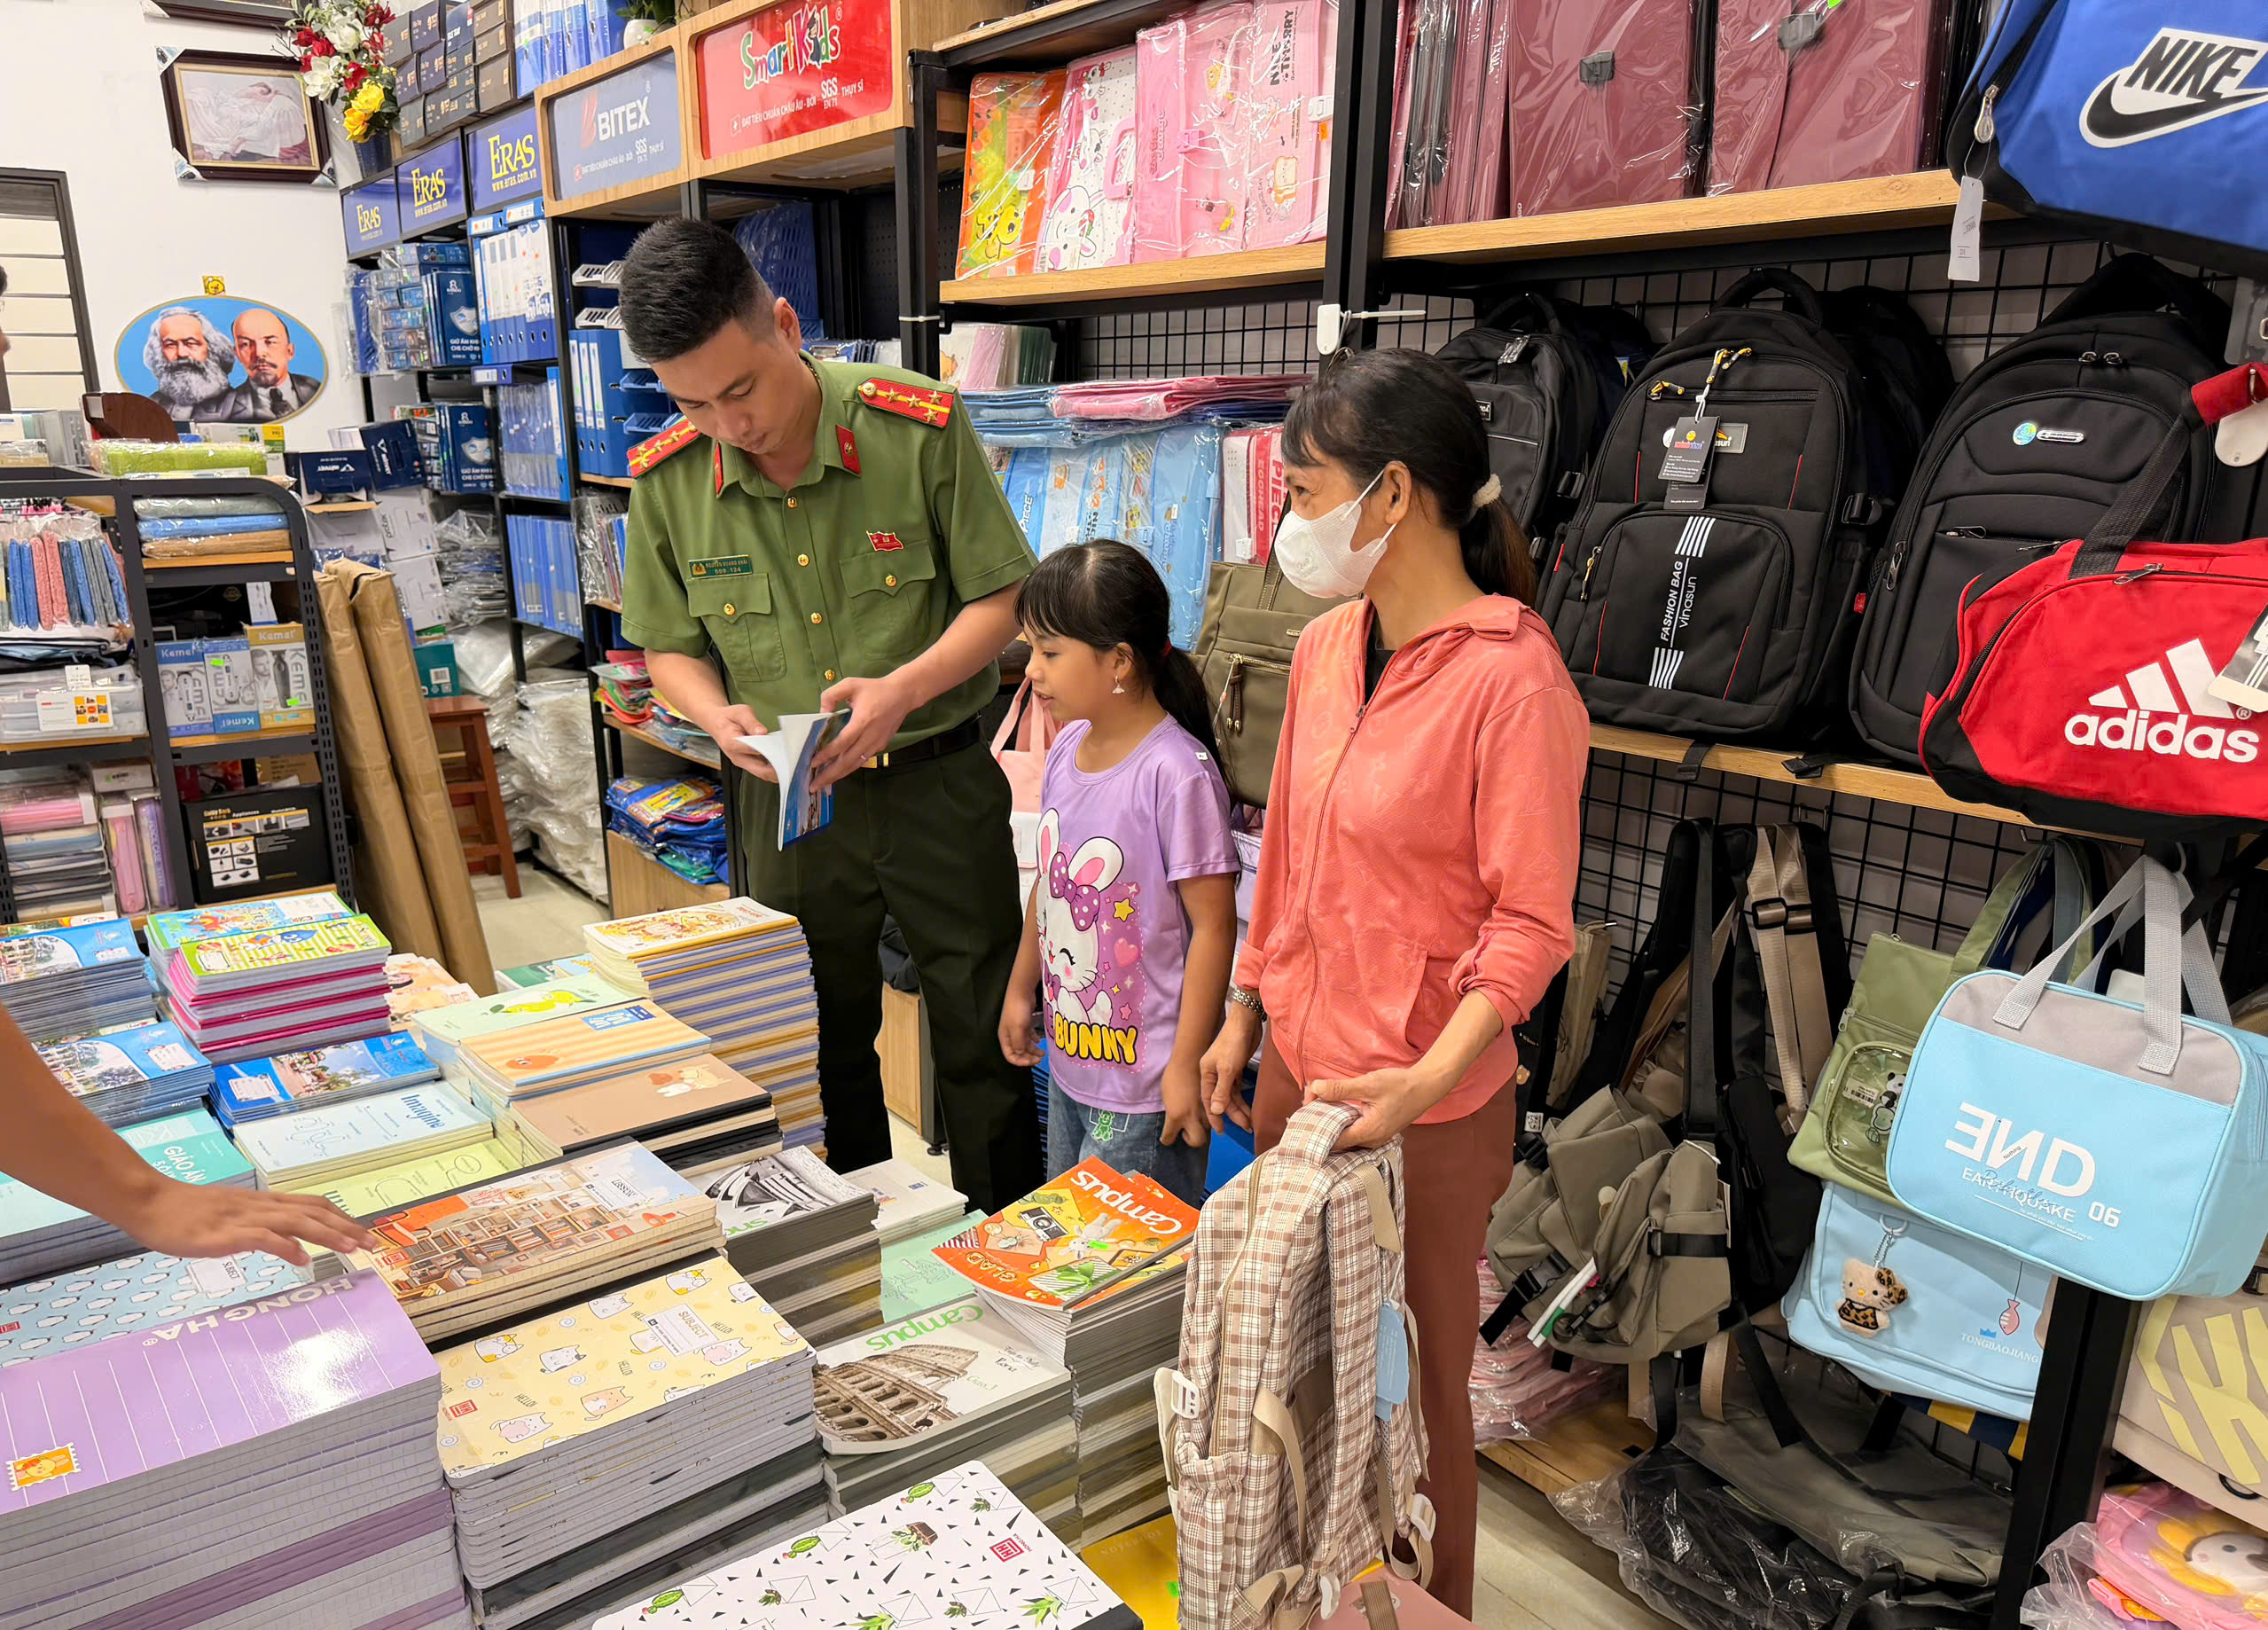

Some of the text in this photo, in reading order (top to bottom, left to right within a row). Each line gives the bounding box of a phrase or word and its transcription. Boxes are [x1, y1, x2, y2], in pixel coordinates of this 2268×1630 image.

[821, 77, 838, 99] SGS
[2123, 35, 2259, 100] NIKE
[598, 96, 651, 141] BITEX
[489, 135, 536, 179] ERAS
[411, 168, 446, 207] ERAS
[356, 204, 382, 233] ERAS
[1661, 560, 1683, 641] FASHION BAG
[1679, 576, 1697, 628] vinasun
[2064, 709, 2259, 763] adidas
[1055, 1012, 1137, 1064] BUNNY
[401, 1094, 445, 1129] Imagine
[2003, 1145, 2022, 1160] Nothing
[1070, 1169, 1183, 1234] Campus
[1962, 1167, 2076, 1222] EARTHQUAKE
[2089, 1201, 2122, 1228] 06
[965, 1250, 1019, 1283] GLAD
[153, 1278, 354, 1342] HONG HA
[678, 1311, 708, 1338] SUBJECT
[866, 1305, 983, 1352] Campus
[1961, 1333, 2039, 1363] TONGBAOJIANG
